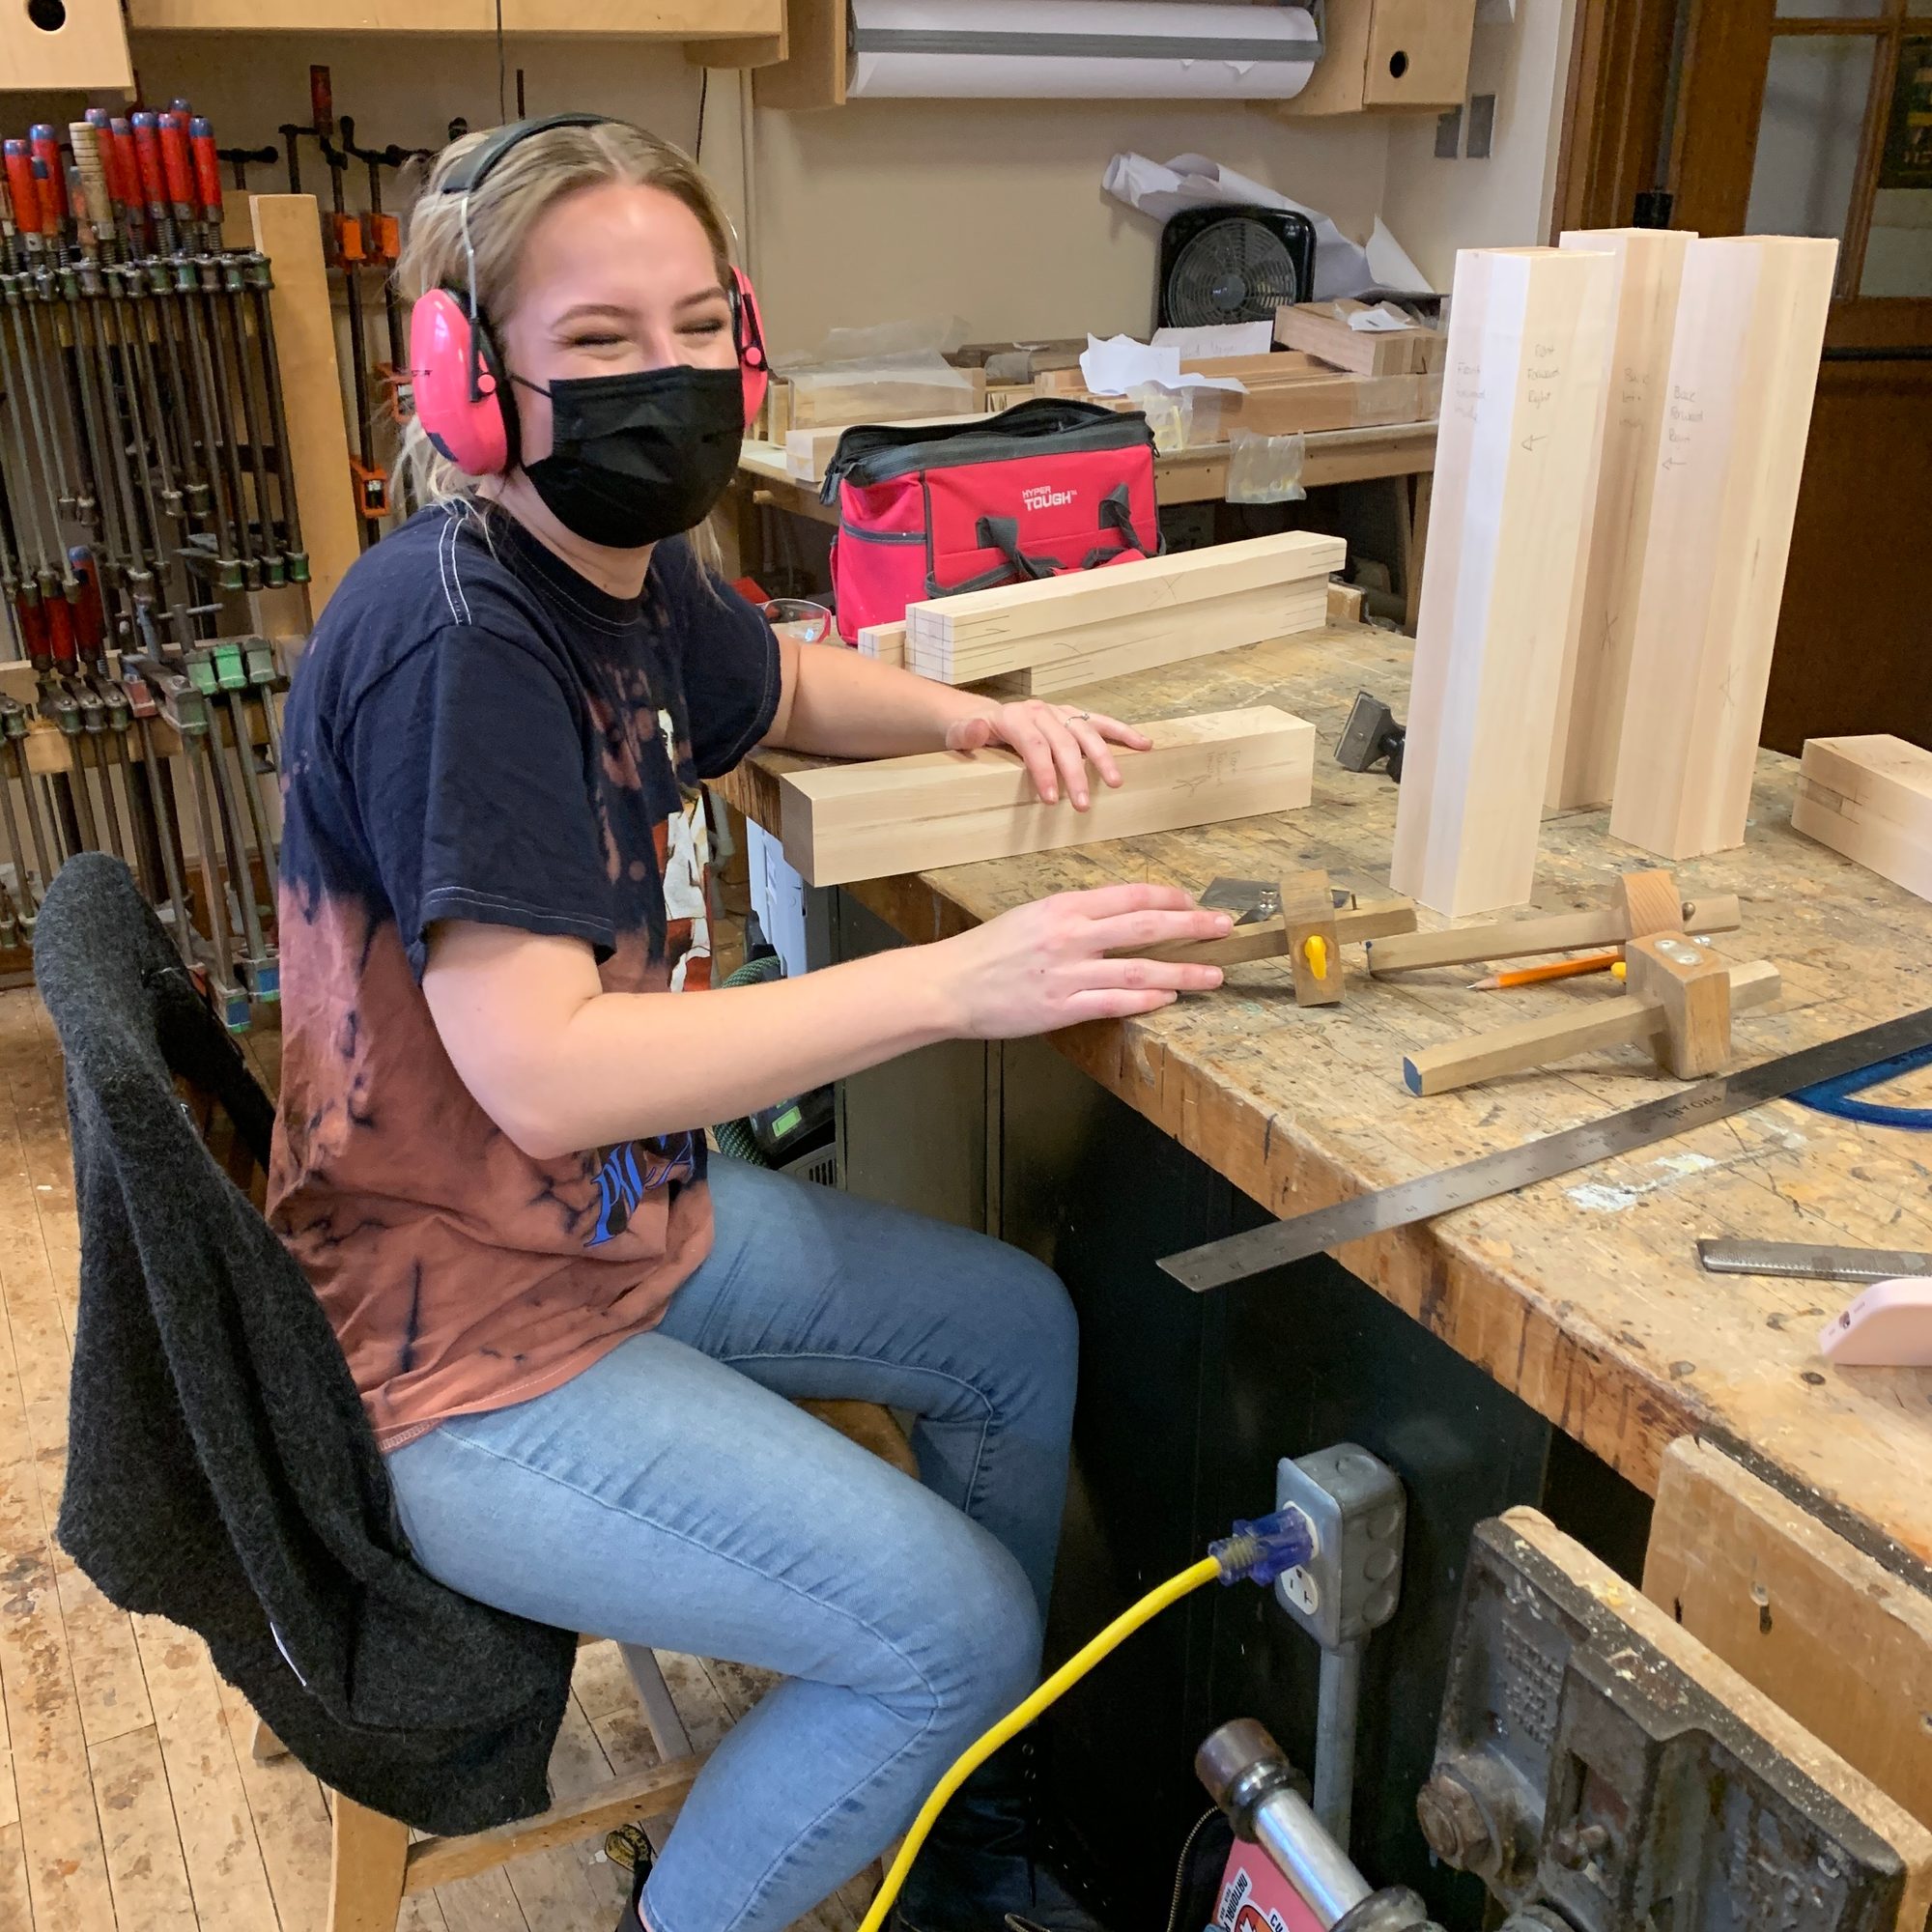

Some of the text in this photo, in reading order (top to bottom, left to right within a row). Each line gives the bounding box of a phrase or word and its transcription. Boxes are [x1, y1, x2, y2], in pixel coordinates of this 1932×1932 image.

[1022, 485, 1051, 498] HYPER
[1691, 1094, 1722, 1109] PRO
[1225, 1873, 1248, 1923] NATIONAL
